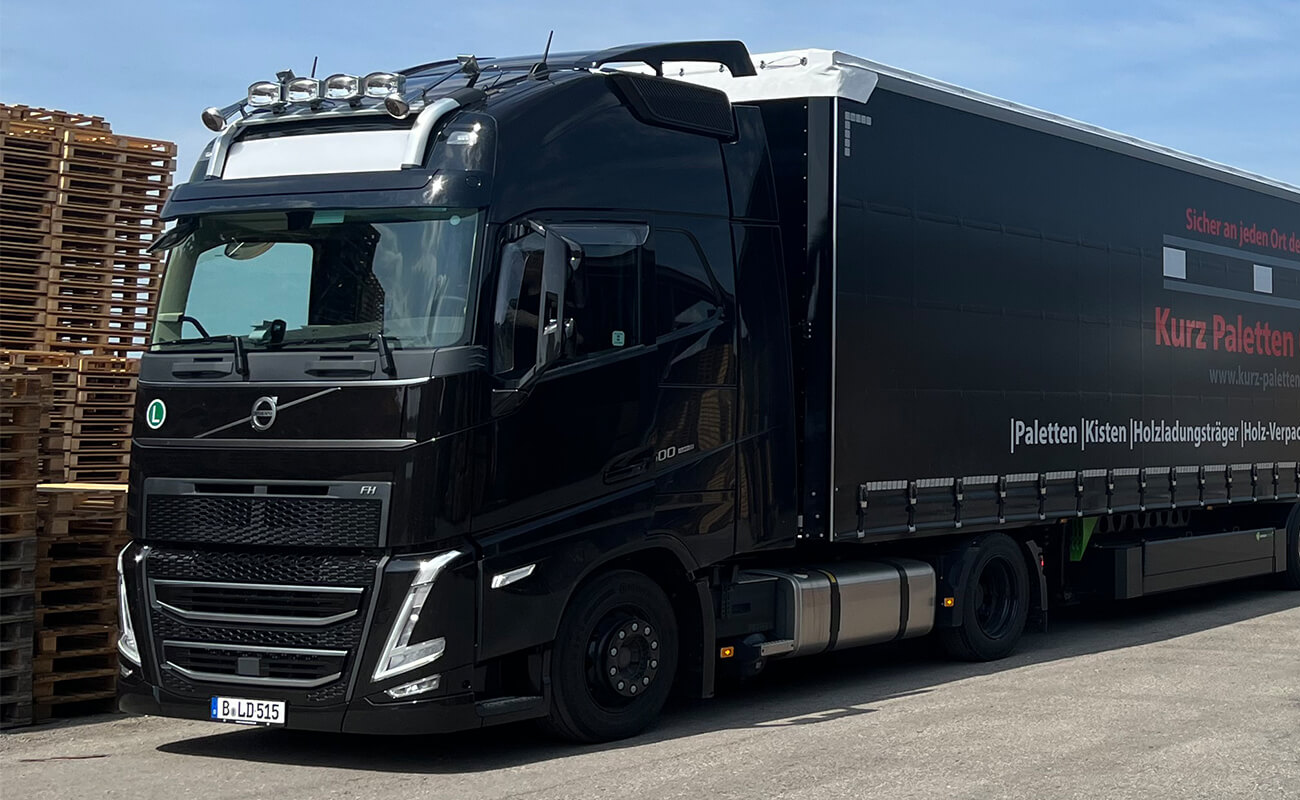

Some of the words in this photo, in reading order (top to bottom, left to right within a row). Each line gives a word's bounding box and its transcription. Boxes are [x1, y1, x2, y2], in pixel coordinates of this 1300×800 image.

[1185, 207, 1221, 236] Sicher
[1223, 221, 1238, 240] an
[1238, 220, 1269, 247] jeden
[1270, 228, 1287, 251] Ort
[1155, 306, 1207, 350] Kurz
[1212, 314, 1294, 358] Paletten
[151, 404, 161, 423] L
[655, 446, 676, 462] 00
[360, 485, 377, 494] FH
[222, 700, 230, 717] B
